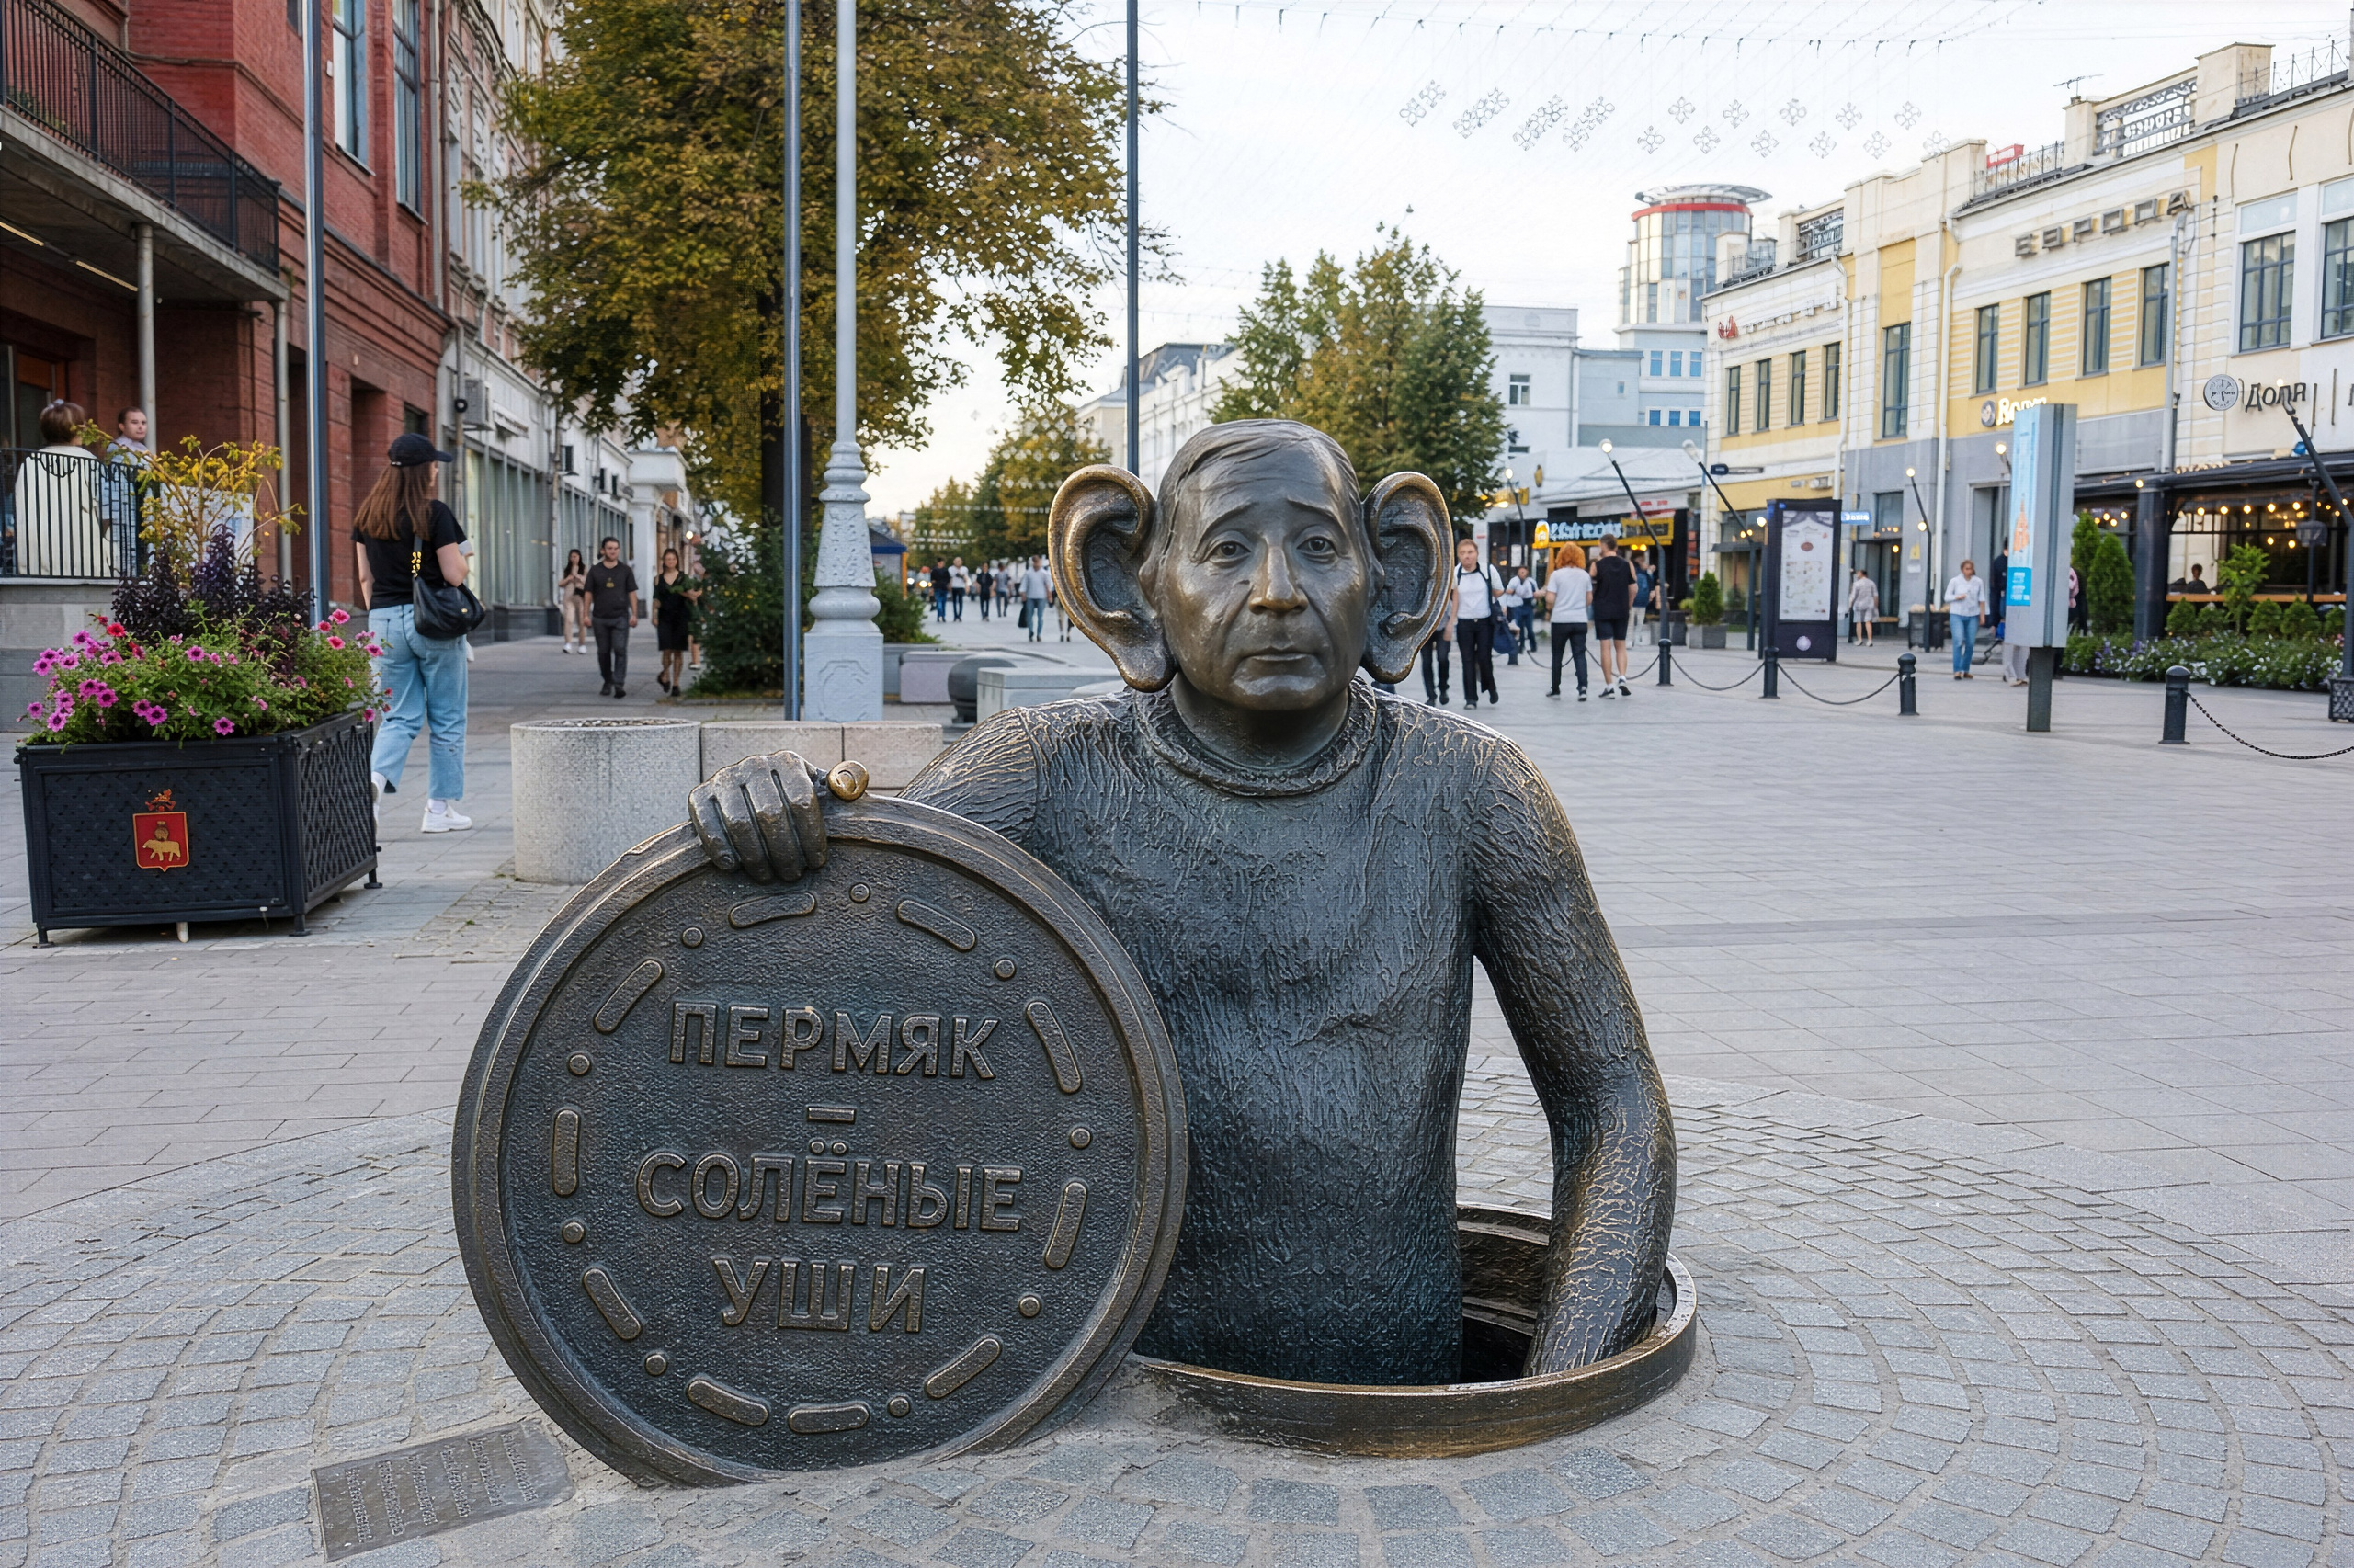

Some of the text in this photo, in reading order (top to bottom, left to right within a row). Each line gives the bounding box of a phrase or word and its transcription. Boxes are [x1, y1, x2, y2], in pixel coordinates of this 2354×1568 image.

[669, 1001, 998, 1079] ПЕРМЯК
[637, 1140, 1024, 1232] СОЛЁНЫЕ
[713, 1256, 926, 1333] УШИ
